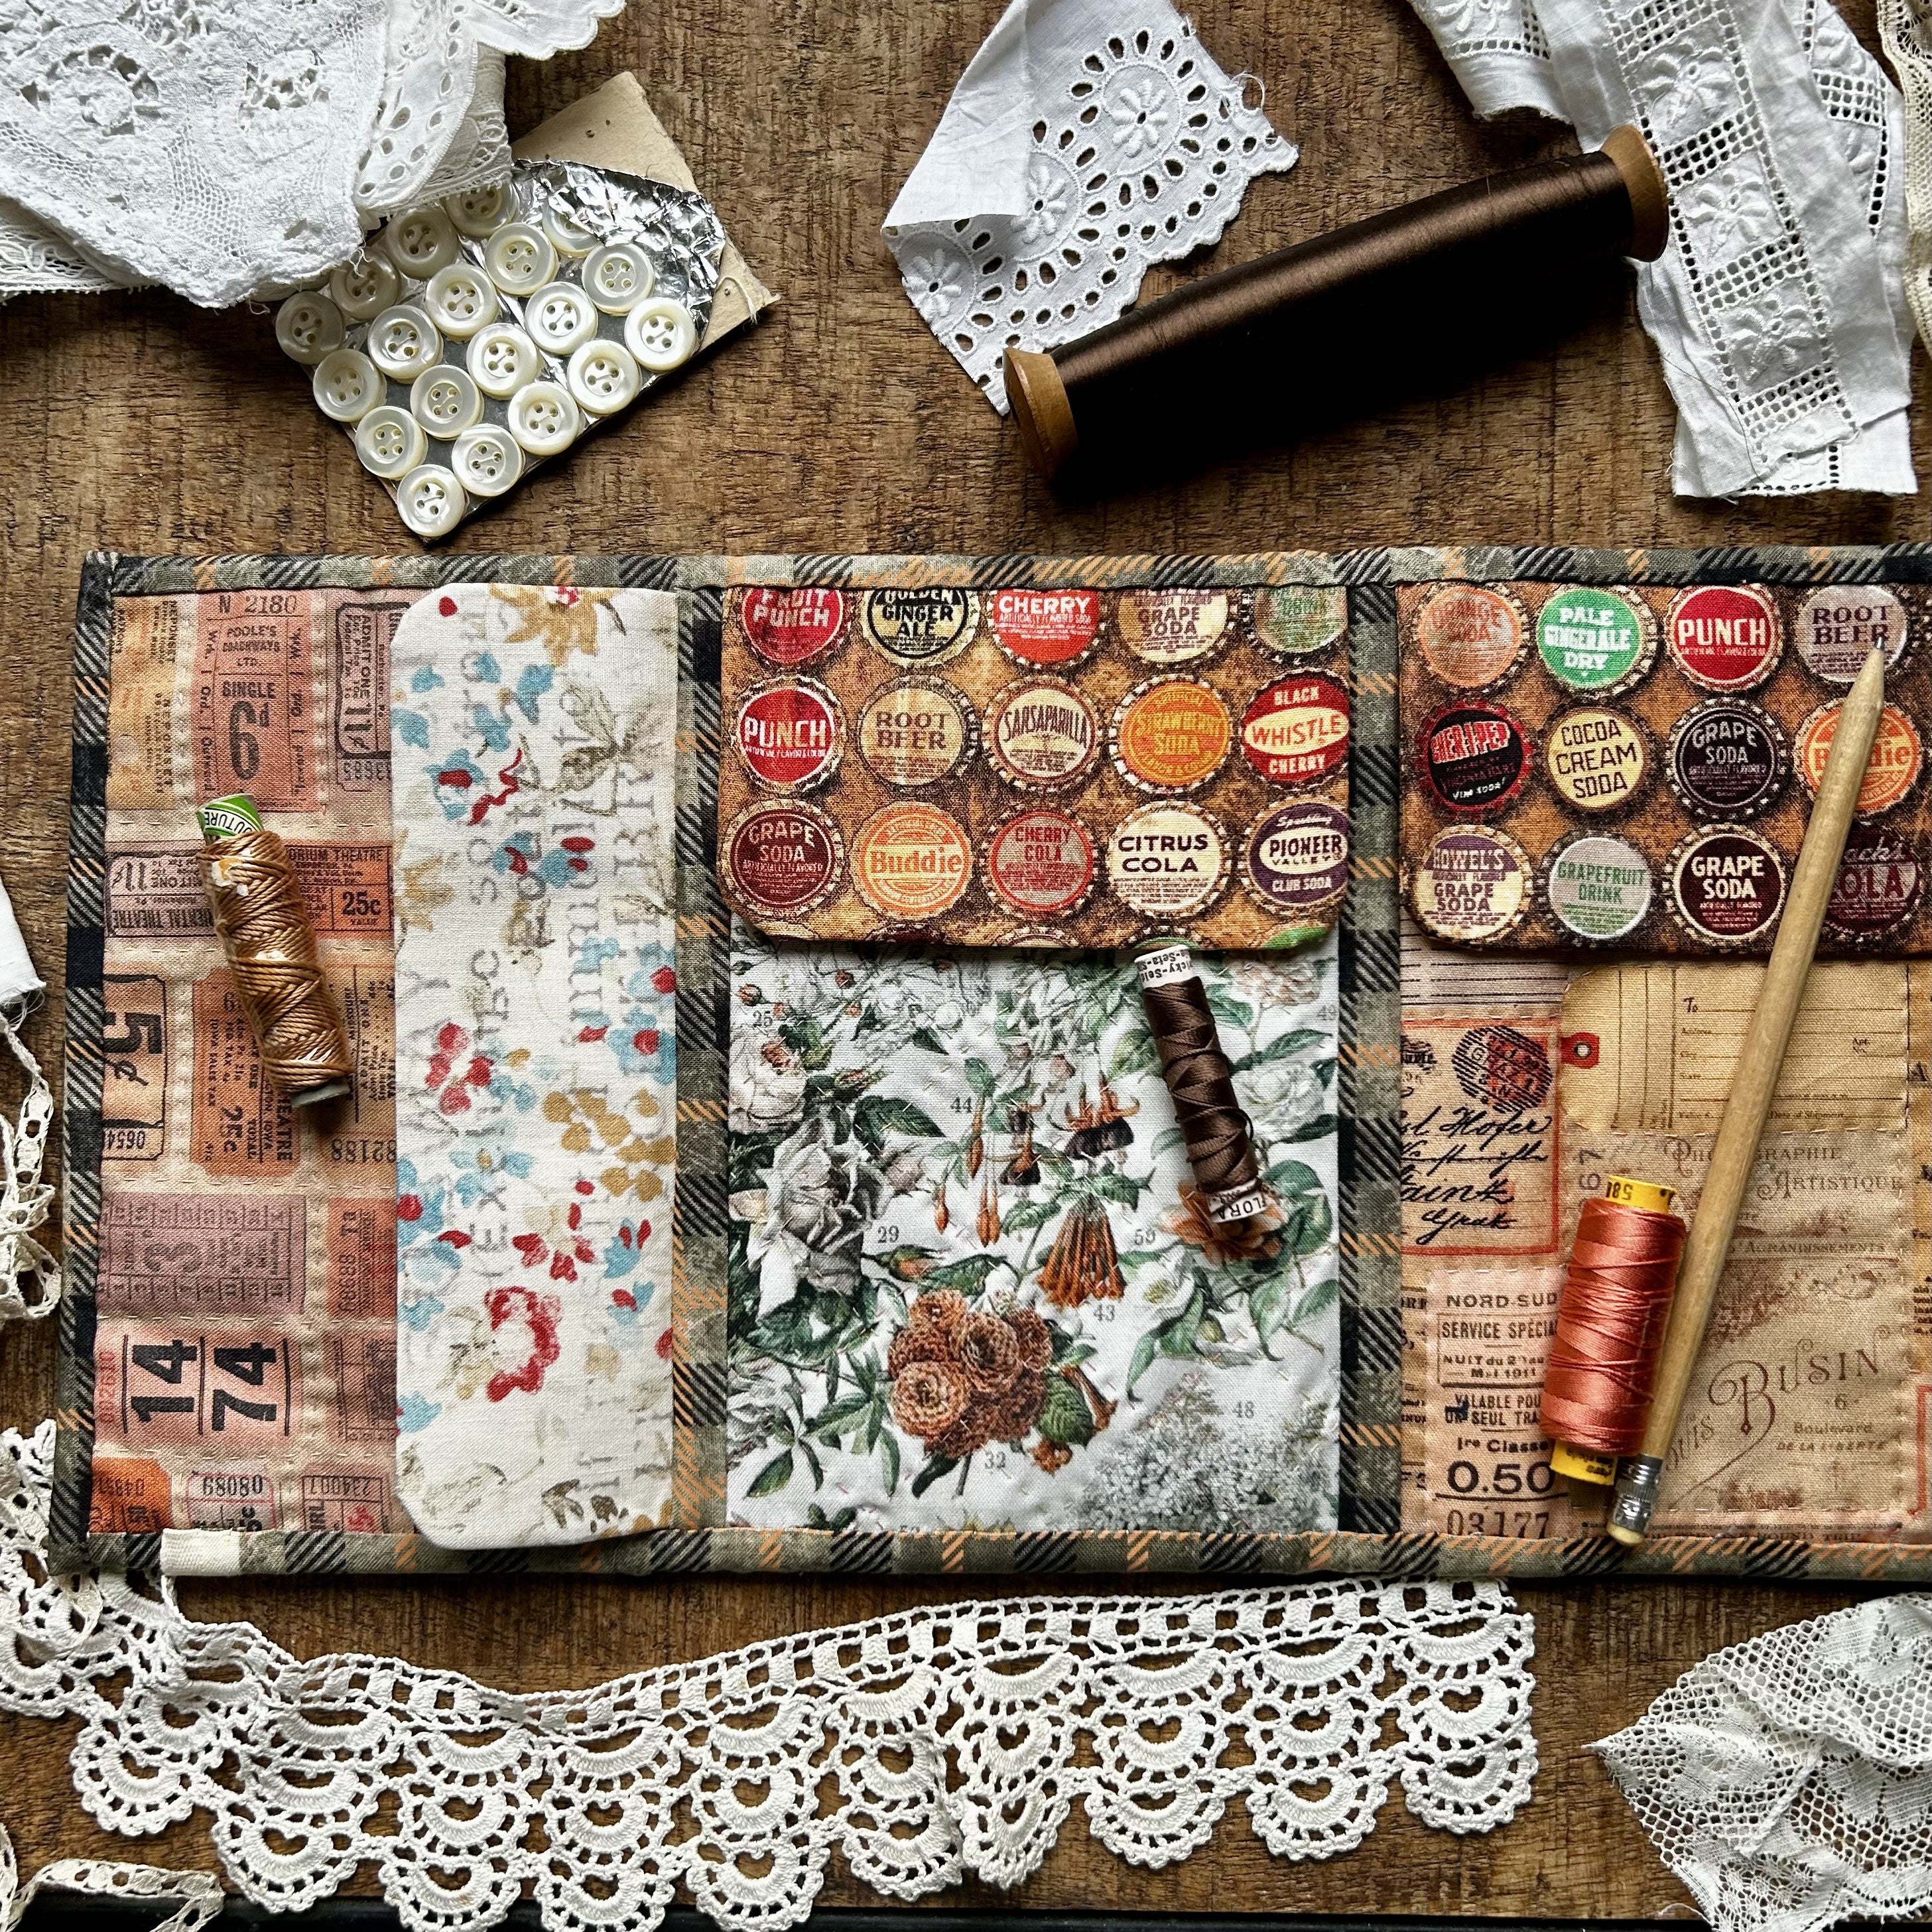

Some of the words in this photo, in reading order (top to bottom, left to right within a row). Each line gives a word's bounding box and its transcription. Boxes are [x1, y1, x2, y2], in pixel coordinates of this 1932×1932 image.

[244, 595, 298, 615] 2180
[882, 605, 954, 622] GINGER
[998, 596, 1091, 615] CHERRY
[1138, 607, 1200, 623] GRAPE
[1812, 605, 1894, 624] ROOT
[753, 606, 830, 627] PUNCH
[1559, 607, 1615, 626] PALE
[896, 620, 935, 638] ALE
[1142, 620, 1196, 637] SODA
[1677, 617, 1766, 646] PUNCH
[1813, 623, 1889, 645] BEER
[361, 615, 371, 664] ADMIT
[1594, 630, 1632, 651] ALE
[1564, 651, 1610, 671] DRY
[360, 666, 371, 699] ONE
[1273, 686, 1319, 706] BLACK
[877, 712, 946, 729] ROOT
[1003, 704, 1088, 749] SARSAPARILLA
[1252, 714, 1342, 747] WHISTLE
[743, 719, 827, 748] PUNCH
[877, 732, 946, 750] BEER
[1561, 718, 1622, 747] COCOA
[1691, 721, 1758, 749] GRAPE
[1555, 742, 1638, 775] CREAM
[1705, 745, 1749, 765] SODA
[1814, 739, 1911, 771] Bdie
[1268, 755, 1325, 776] CHERRY
[1573, 771, 1628, 799] SODA
[749, 820, 816, 849] GRAPE
[1015, 826, 1072, 843] CHERRY
[1118, 834, 1209, 852] CITRUS
[332, 848, 383, 862] THEATRE
[759, 844, 805, 862] SODA
[1024, 844, 1062, 862] COLA
[1268, 834, 1342, 858] PIONEER
[870, 846, 962, 873] Buddie
[1122, 856, 1199, 873] COLA
[1691, 855, 1765, 877] GRAPE
[1557, 862, 1647, 885] GRAPEFRUIT
[1837, 866, 1905, 899] OLA
[1271, 879, 1301, 893] CLUB
[1302, 876, 1332, 890] SODA
[1433, 883, 1494, 898] GRAPE
[1703, 877, 1757, 900] SODA
[342, 890, 381, 916] 25c
[1436, 897, 1491, 913] SODA
[1577, 885, 1623, 905] DRINK
[1683, 996, 1699, 1013] To
[950, 1096, 972, 1114] 44
[264, 1120, 273, 1150] IOWA
[877, 1226, 900, 1244] 29
[1092, 1304, 1116, 1322] 43
[1441, 1321, 1501, 1339] SERVICE
[1443, 1354, 1484, 1366] NUIT
[1486, 1356, 1504, 1366] du
[130, 1338, 198, 1423] 14
[211, 1341, 277, 1432] 74
[1232, 1401, 1256, 1419] 48
[1454, 1393, 1511, 1409] VALABLE
[1471, 1411, 1506, 1425] SEUL
[1447, 1460, 1556, 1494] 0.50
[1447, 1509, 1551, 1539] 03177
